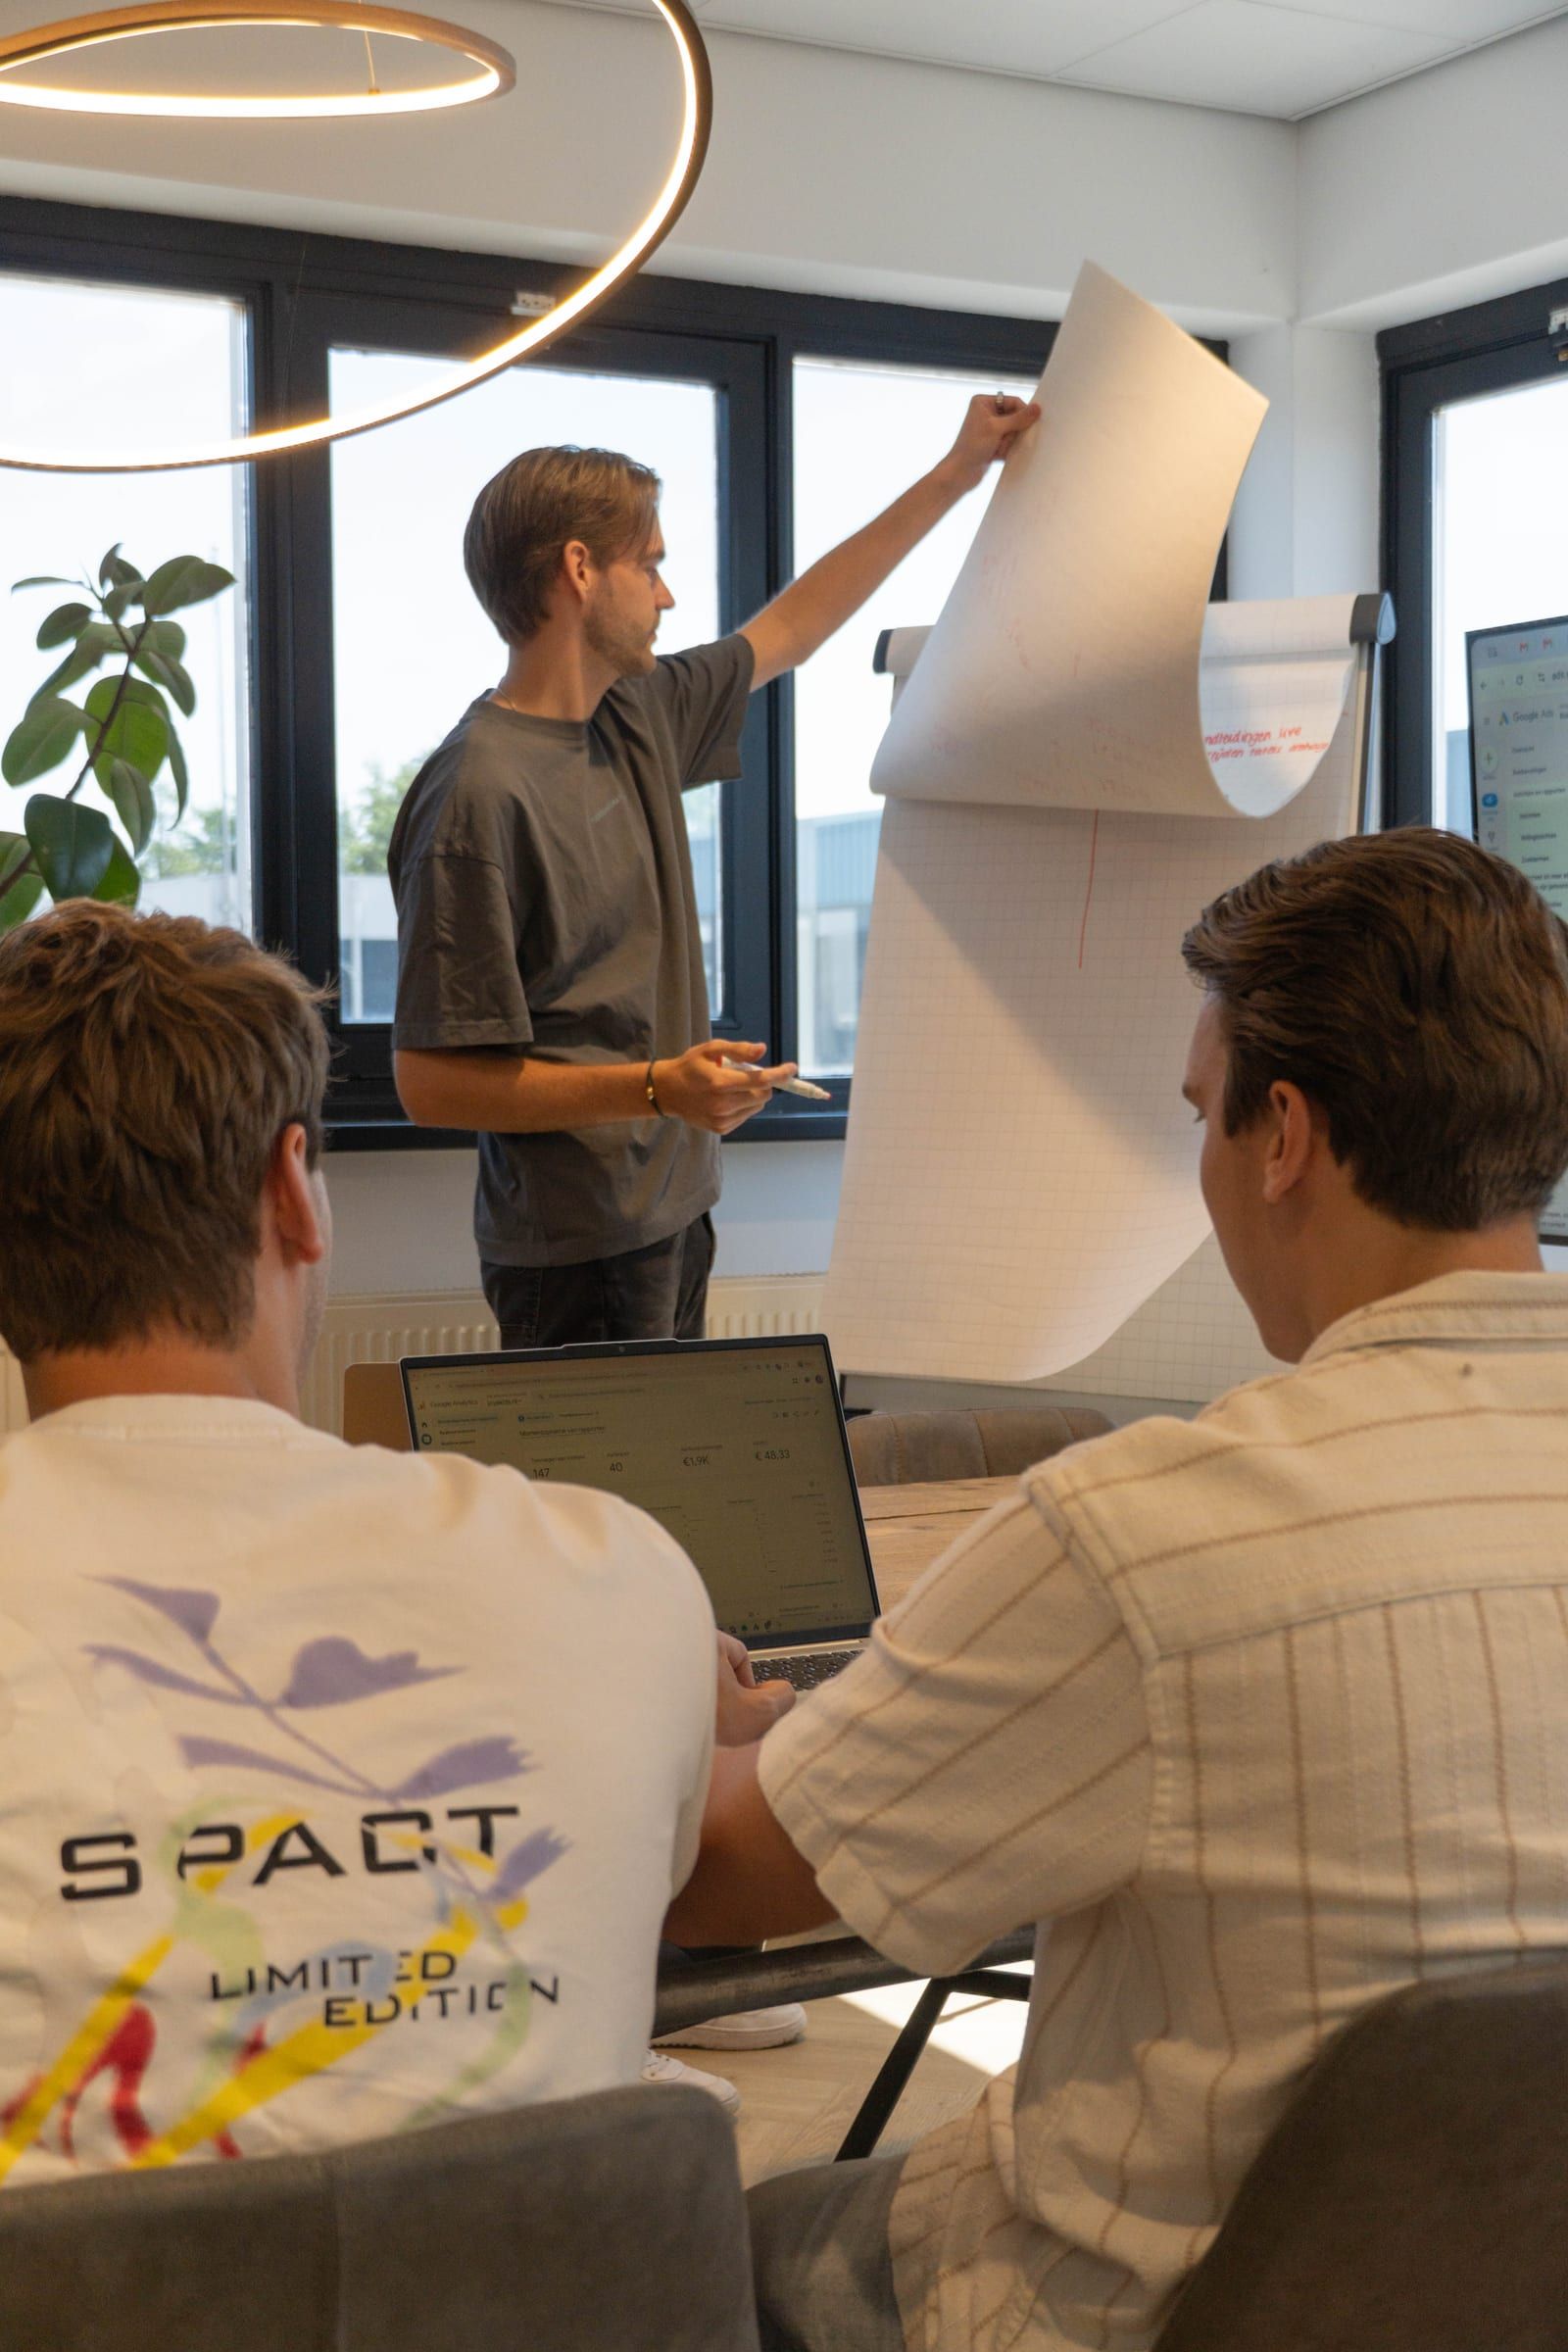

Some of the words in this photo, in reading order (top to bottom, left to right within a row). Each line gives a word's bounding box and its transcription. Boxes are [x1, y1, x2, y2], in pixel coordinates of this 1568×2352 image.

[1512, 710, 1538, 723] Google
[1204, 731, 1271, 747] ndleidingen
[610, 1462, 623, 1473] 40
